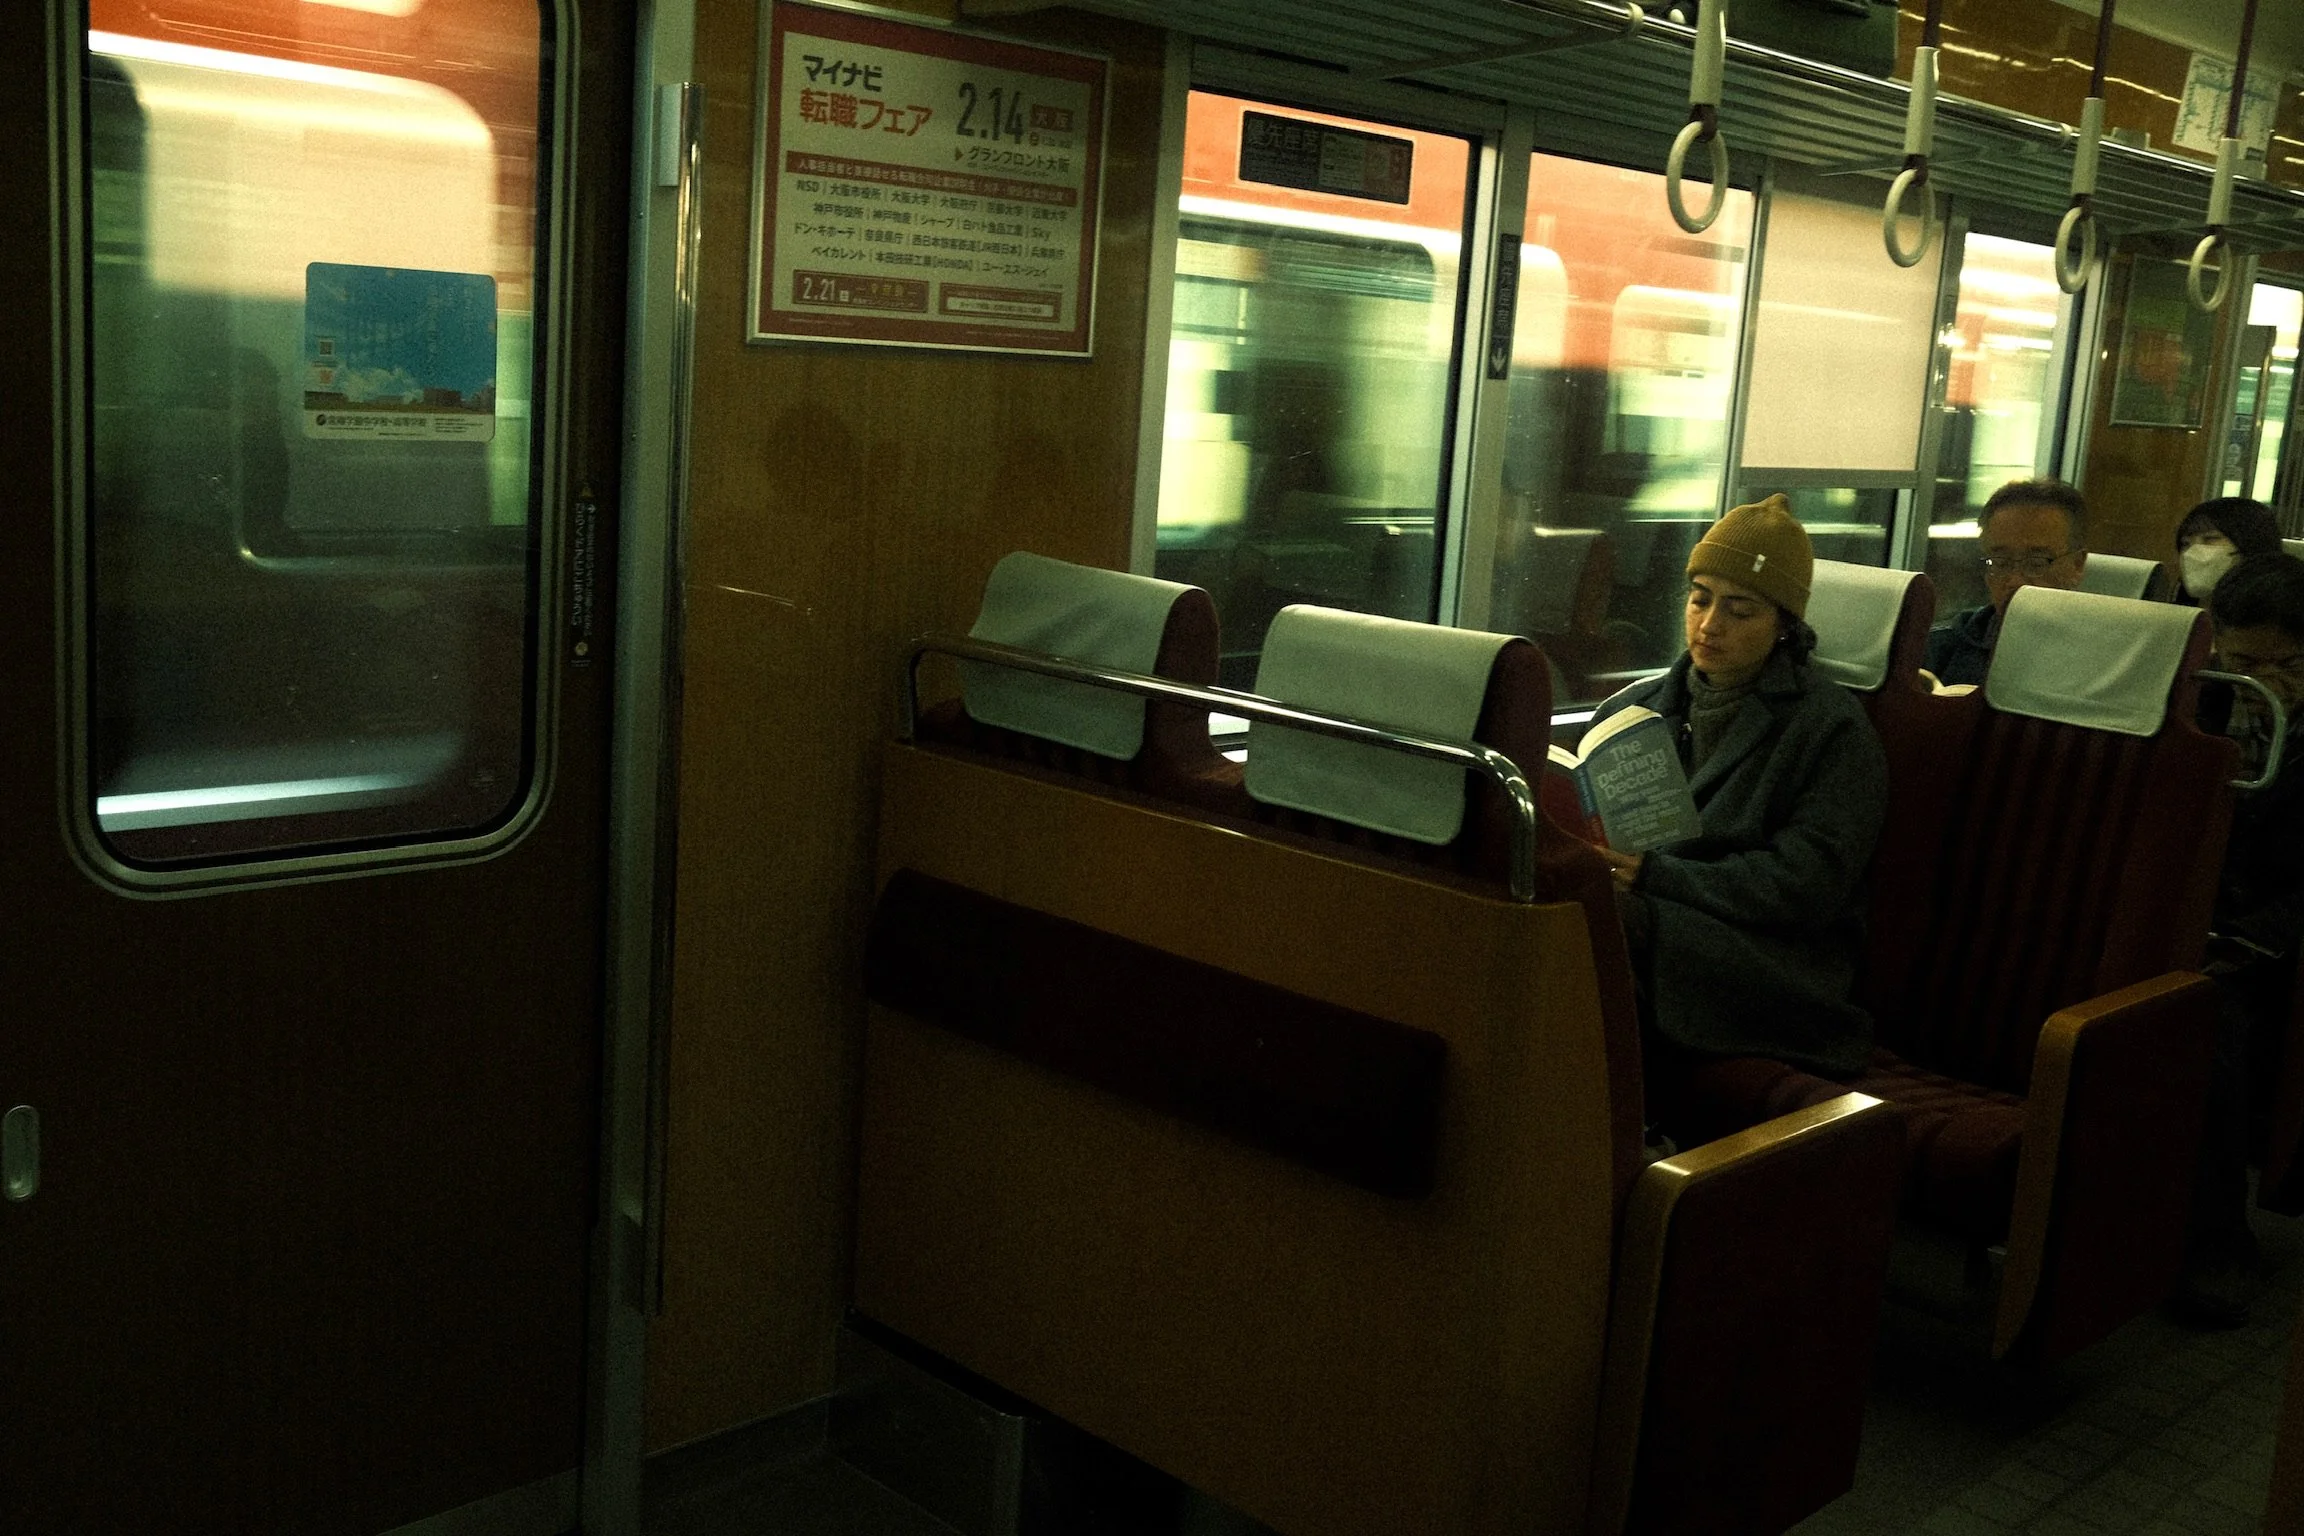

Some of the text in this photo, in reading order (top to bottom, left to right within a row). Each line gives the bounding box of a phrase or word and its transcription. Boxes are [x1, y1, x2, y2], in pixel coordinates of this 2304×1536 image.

[802, 54, 882, 92] マイナビ
[800, 87, 932, 136] 転職フェア
[955, 82, 1024, 145] 2.14
[968, 146, 1070, 172] グランフロント大阪
[811, 246, 866, 261] ベイカレント
[803, 277, 836, 302] 2.21
[1597, 747, 1668, 788] Defining
[1610, 739, 1642, 762] The
[1603, 765, 1669, 800] Decade
